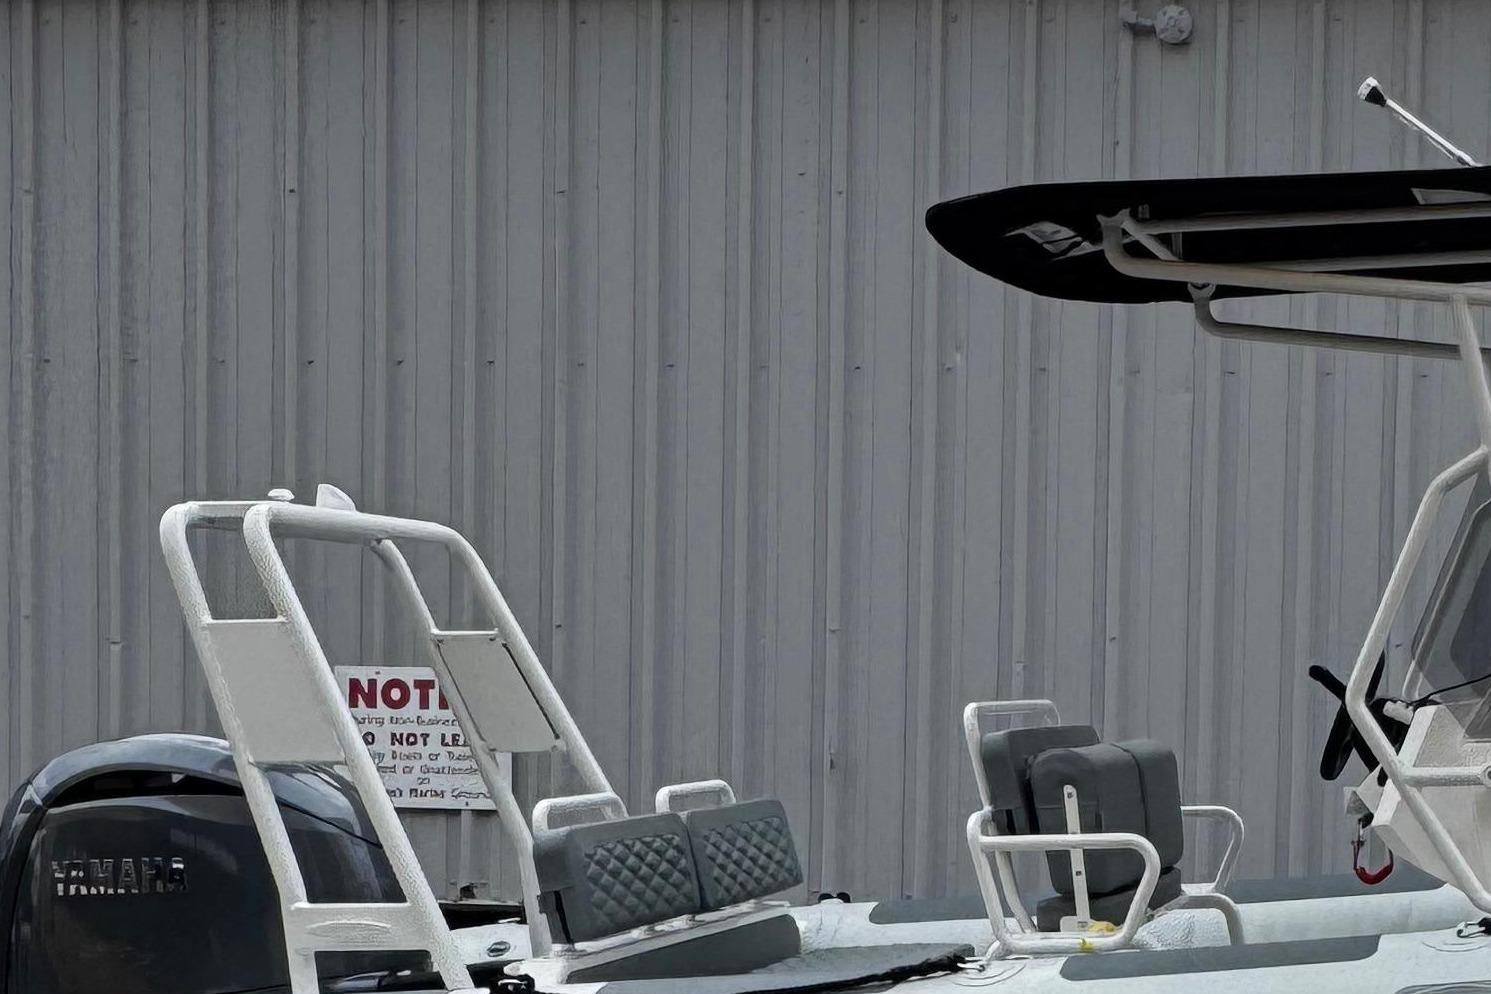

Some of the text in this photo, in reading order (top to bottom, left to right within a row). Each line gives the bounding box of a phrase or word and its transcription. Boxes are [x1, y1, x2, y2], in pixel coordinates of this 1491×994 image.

[361, 731, 376, 746] O
[390, 732, 430, 747] NOT
[52, 857, 187, 896] YAMAHA
